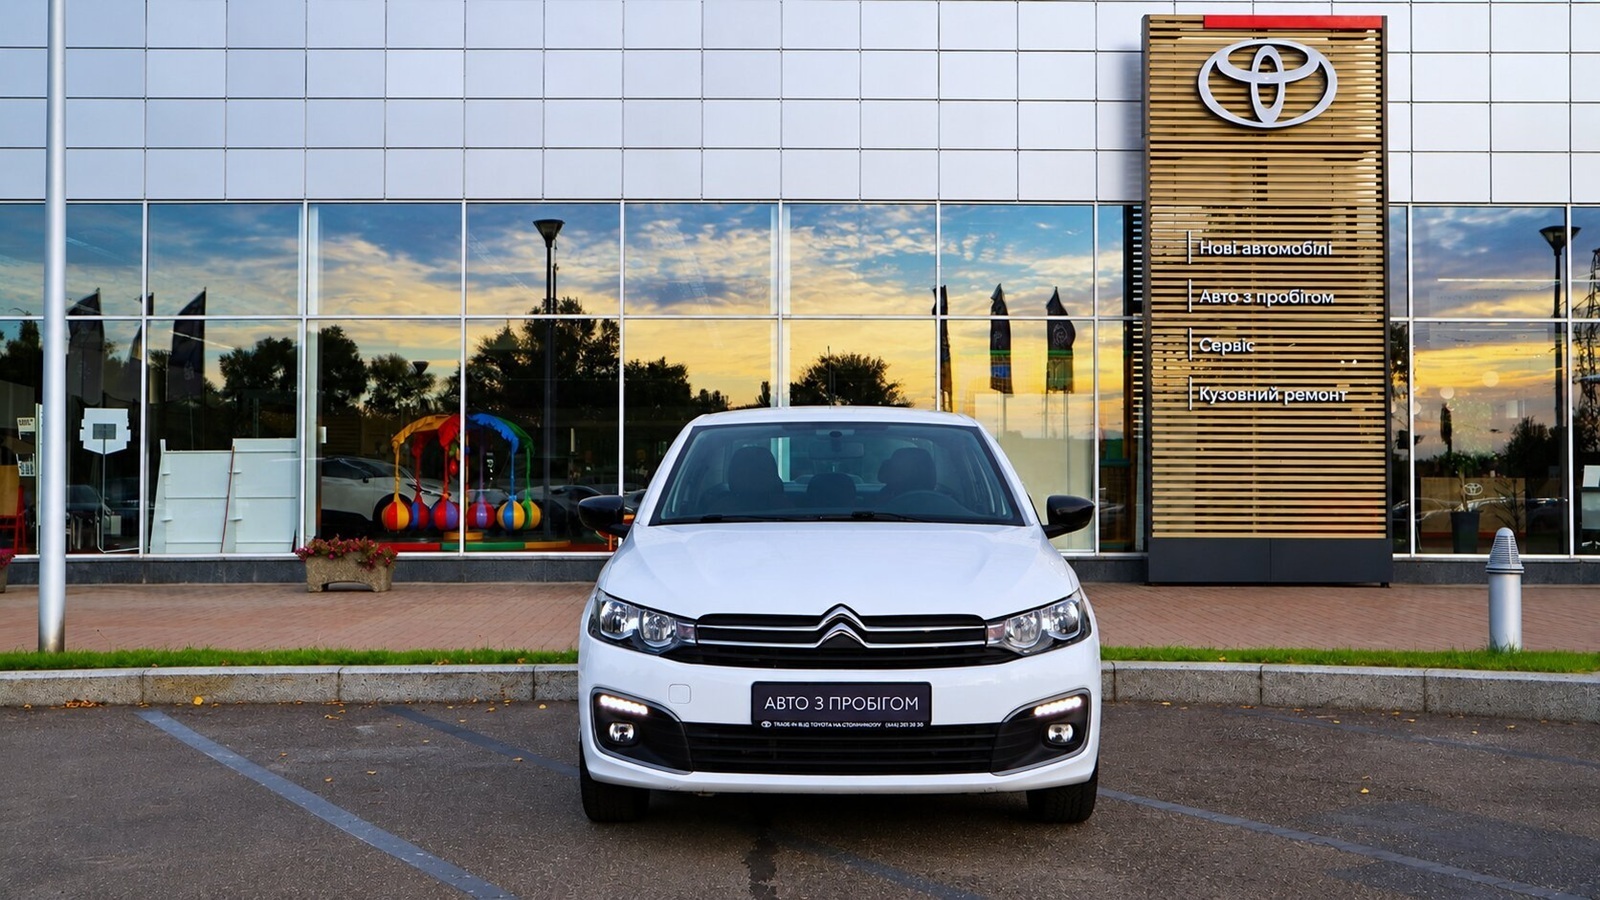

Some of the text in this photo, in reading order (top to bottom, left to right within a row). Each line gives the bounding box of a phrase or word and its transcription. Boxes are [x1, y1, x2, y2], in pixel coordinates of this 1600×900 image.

[1199, 241, 1333, 255] Нові автомобілі
[1199, 289, 1335, 307] Авто з пробігом
[1199, 338, 1255, 355] Сервіс
[1199, 387, 1348, 406] Кузовний ремонт
[764, 696, 919, 711] АВТО З ПРОБІГОМ
